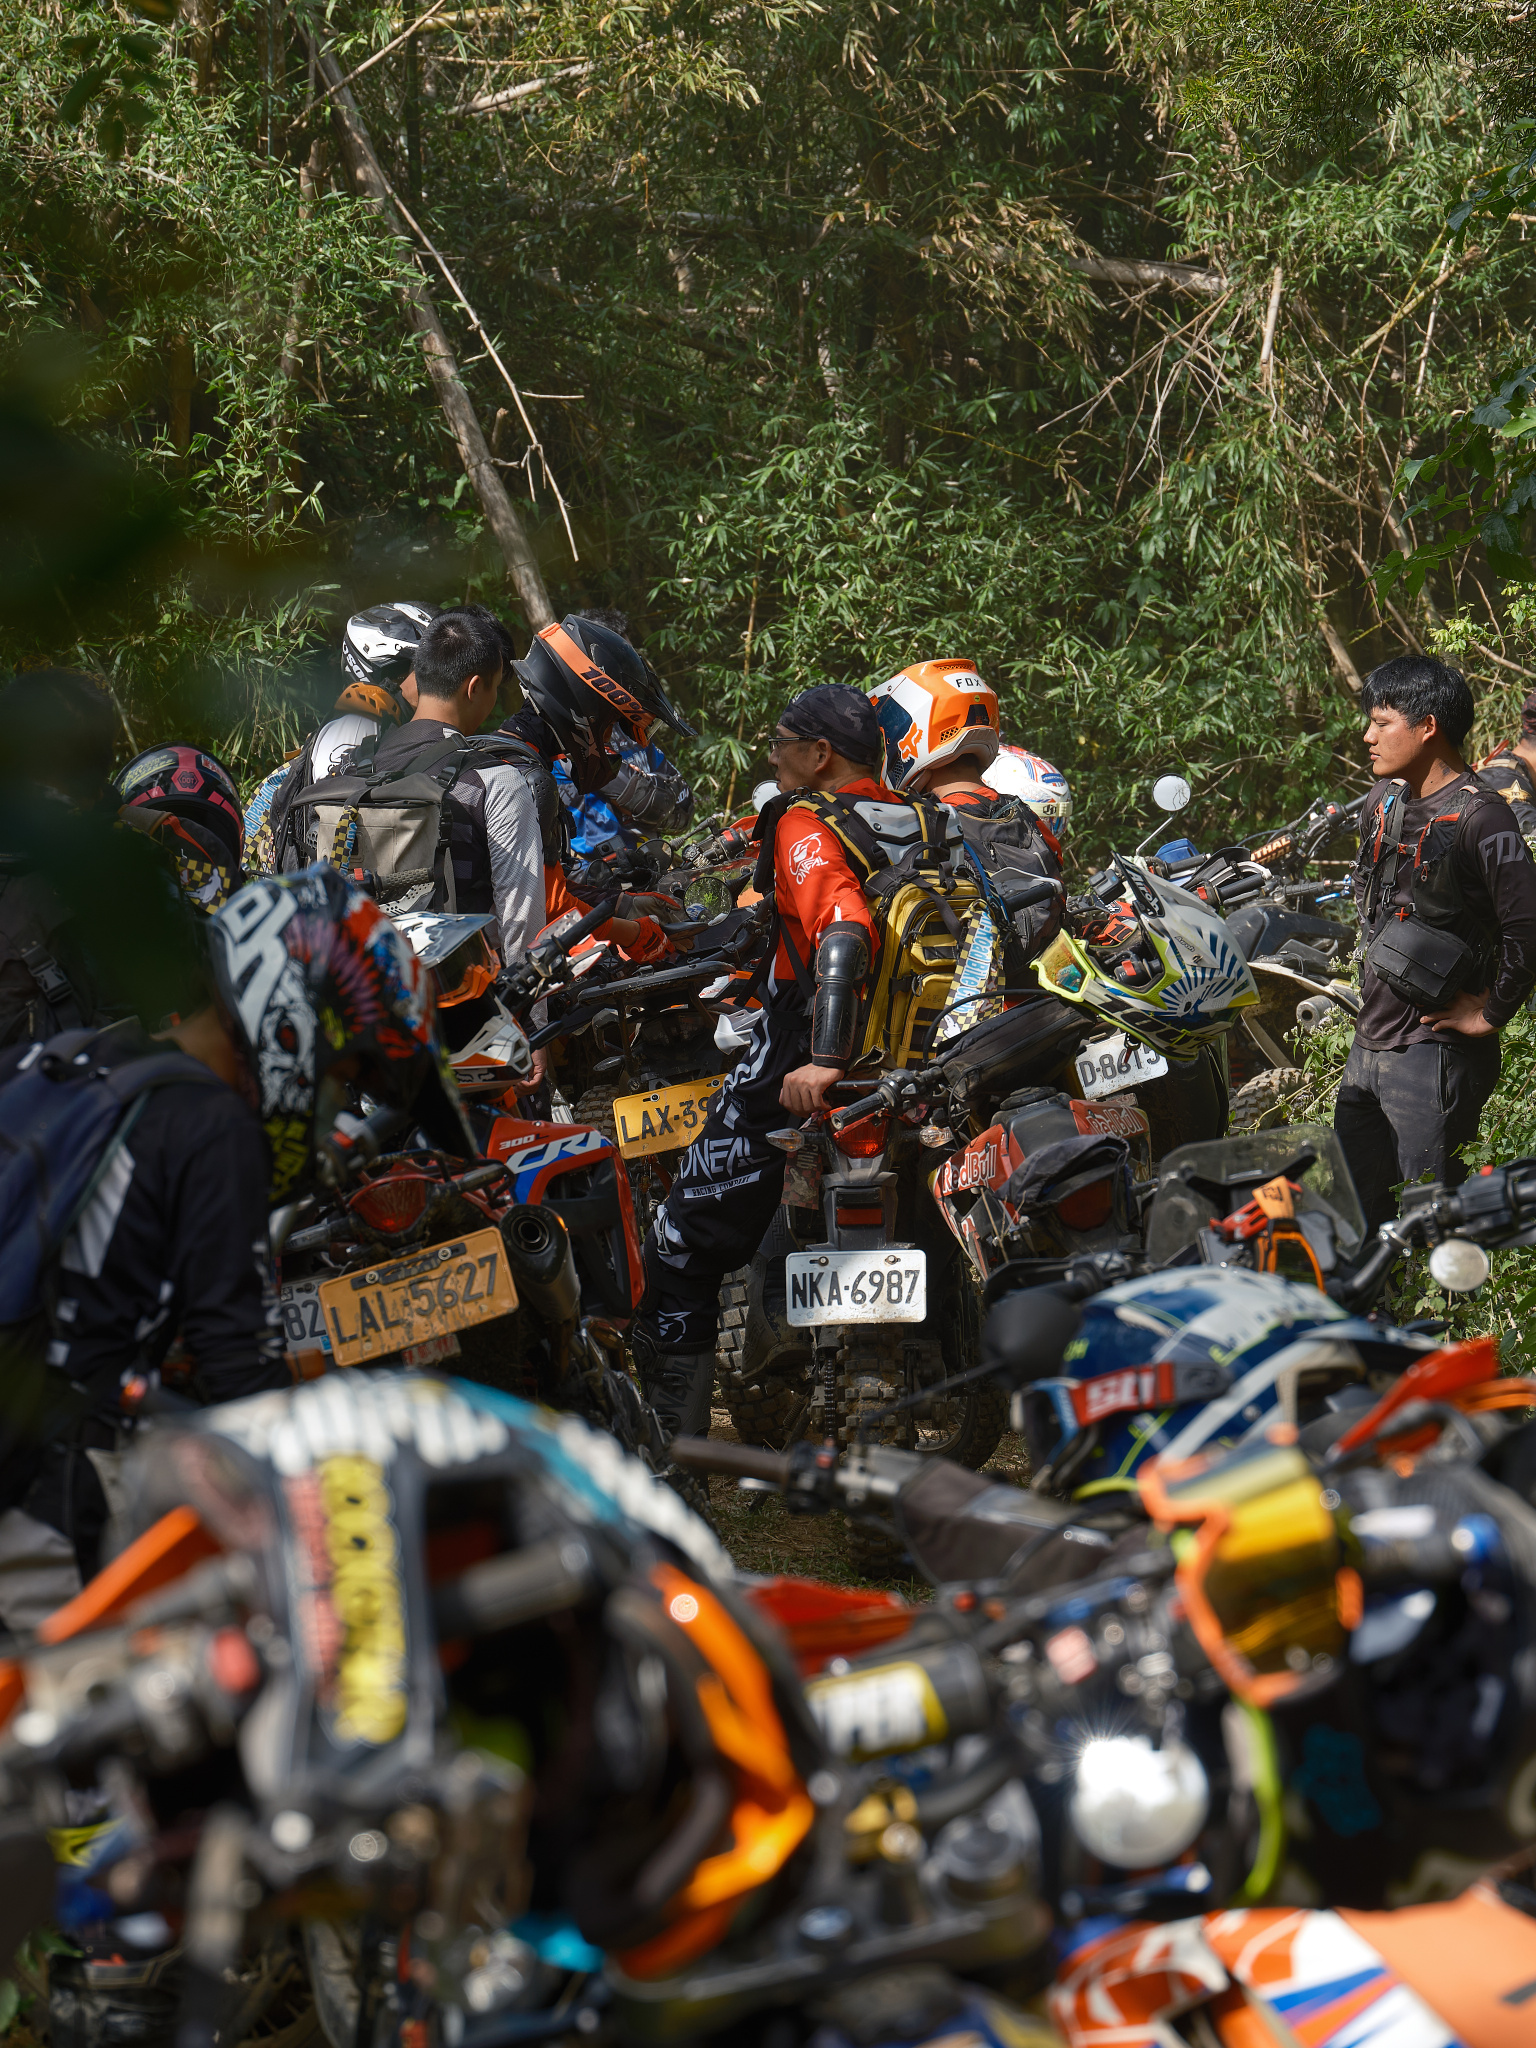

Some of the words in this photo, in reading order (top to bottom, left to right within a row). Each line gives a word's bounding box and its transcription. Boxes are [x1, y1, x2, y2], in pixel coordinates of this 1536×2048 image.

[580, 666, 648, 722] 100%
[955, 677, 982, 688] FOX
[1477, 831, 1531, 875] FOX
[960, 958, 990, 987] Bike
[691, 1185, 717, 1197] RACING
[330, 1252, 499, 1345] LAL-5627
[791, 1269, 921, 1310] NKA-6987
